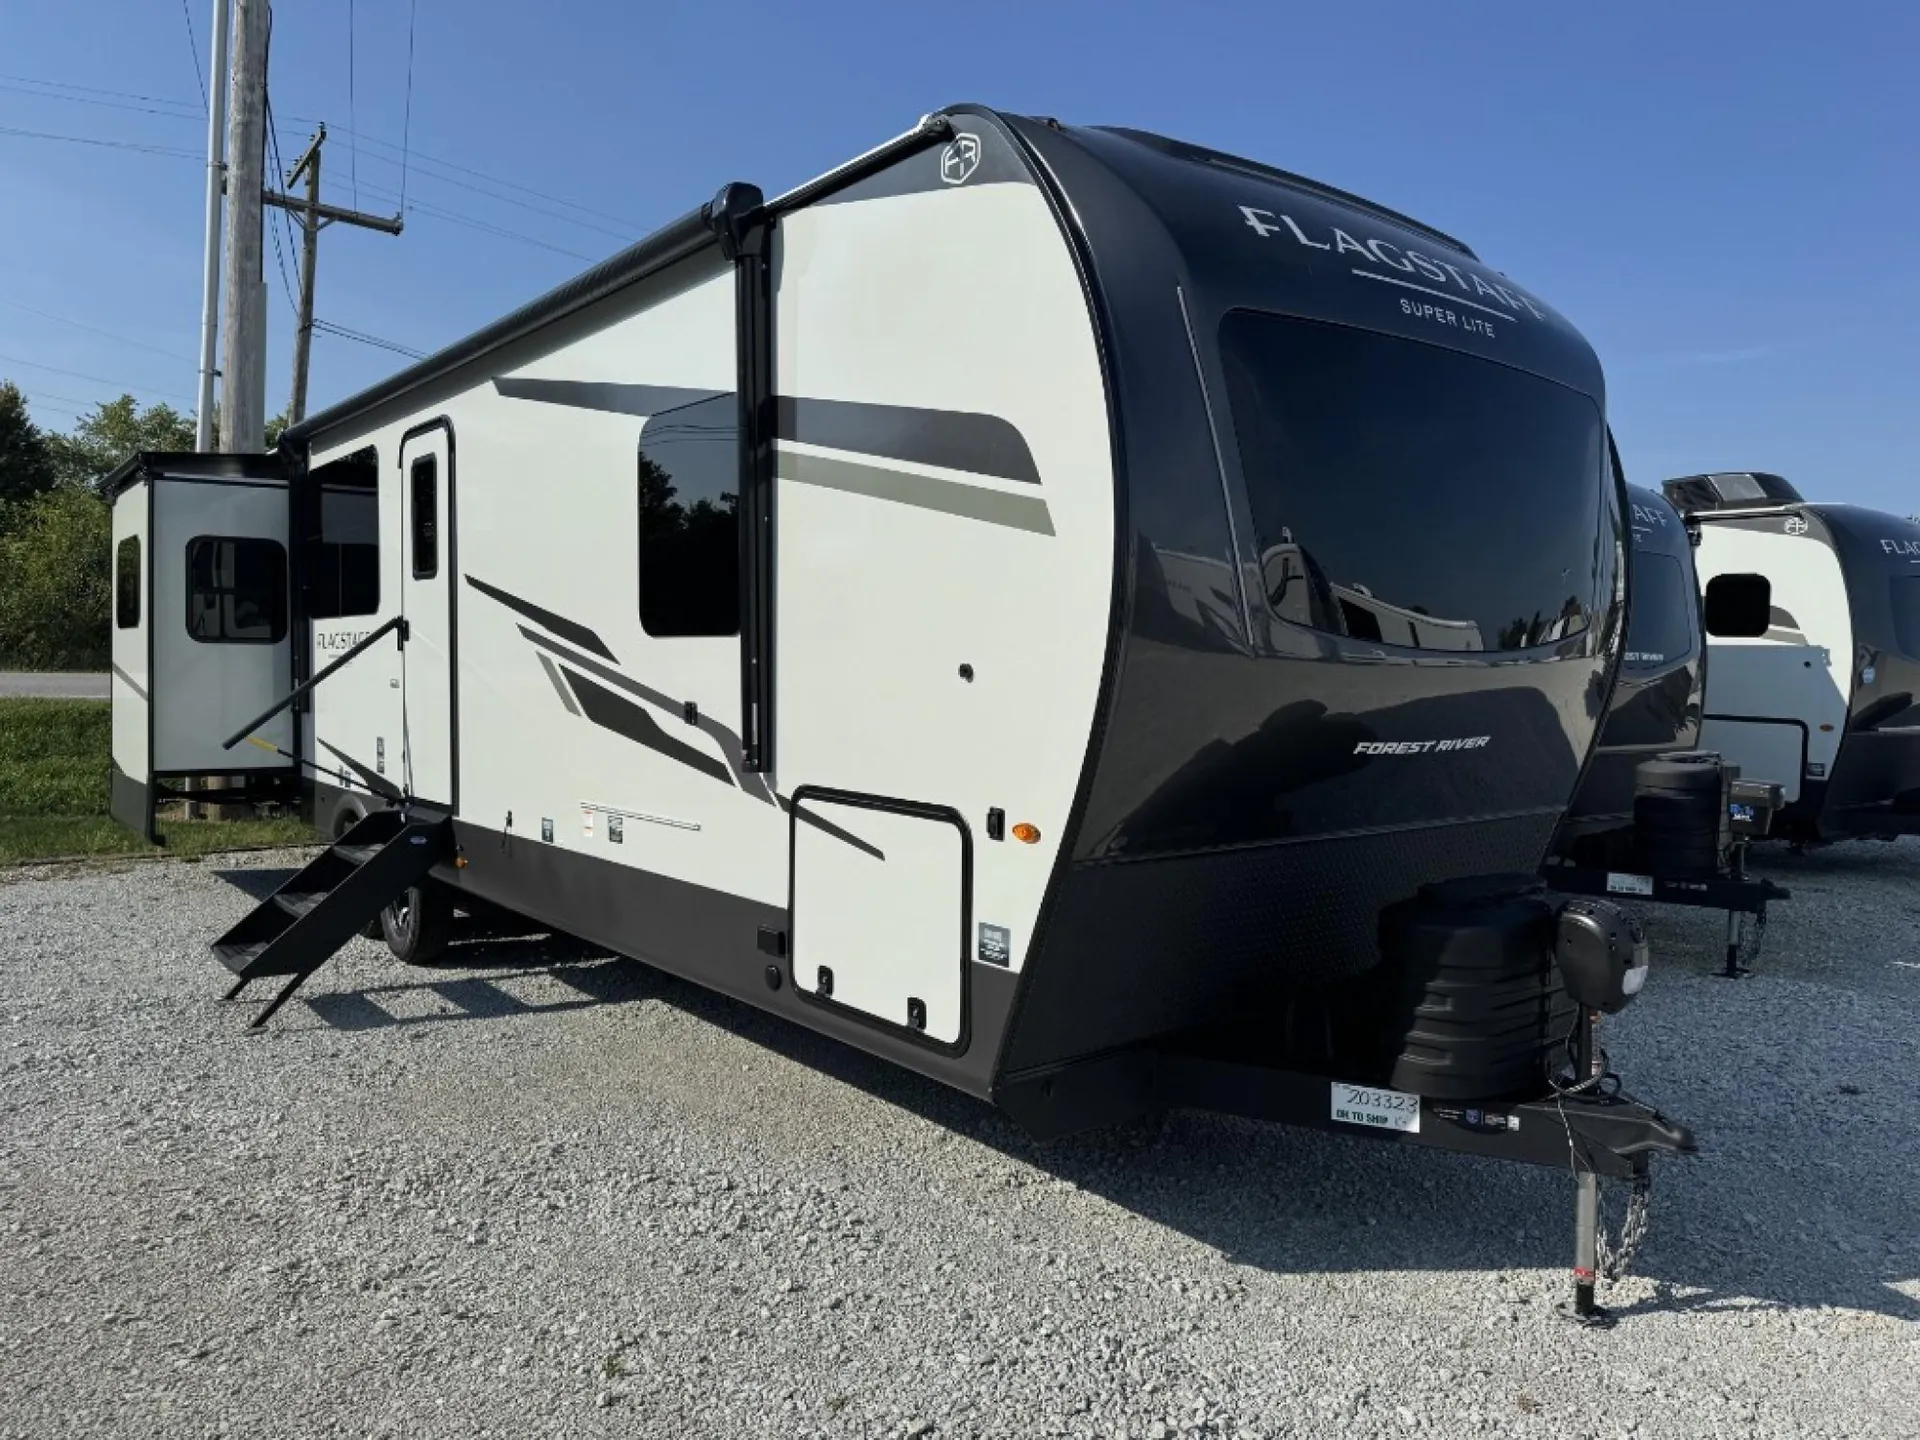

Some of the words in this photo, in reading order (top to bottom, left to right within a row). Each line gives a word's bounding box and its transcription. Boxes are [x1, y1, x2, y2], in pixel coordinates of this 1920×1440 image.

[1238, 204, 1546, 321] FLAGSTAFF
[1400, 297, 1457, 327] SUPER
[1462, 315, 1496, 339] LITE
[1353, 741, 1437, 755] FOREST
[1435, 735, 1491, 752] RIVER
[1352, 1110, 1364, 1121] TO
[1366, 1113, 1389, 1124] SHIP
